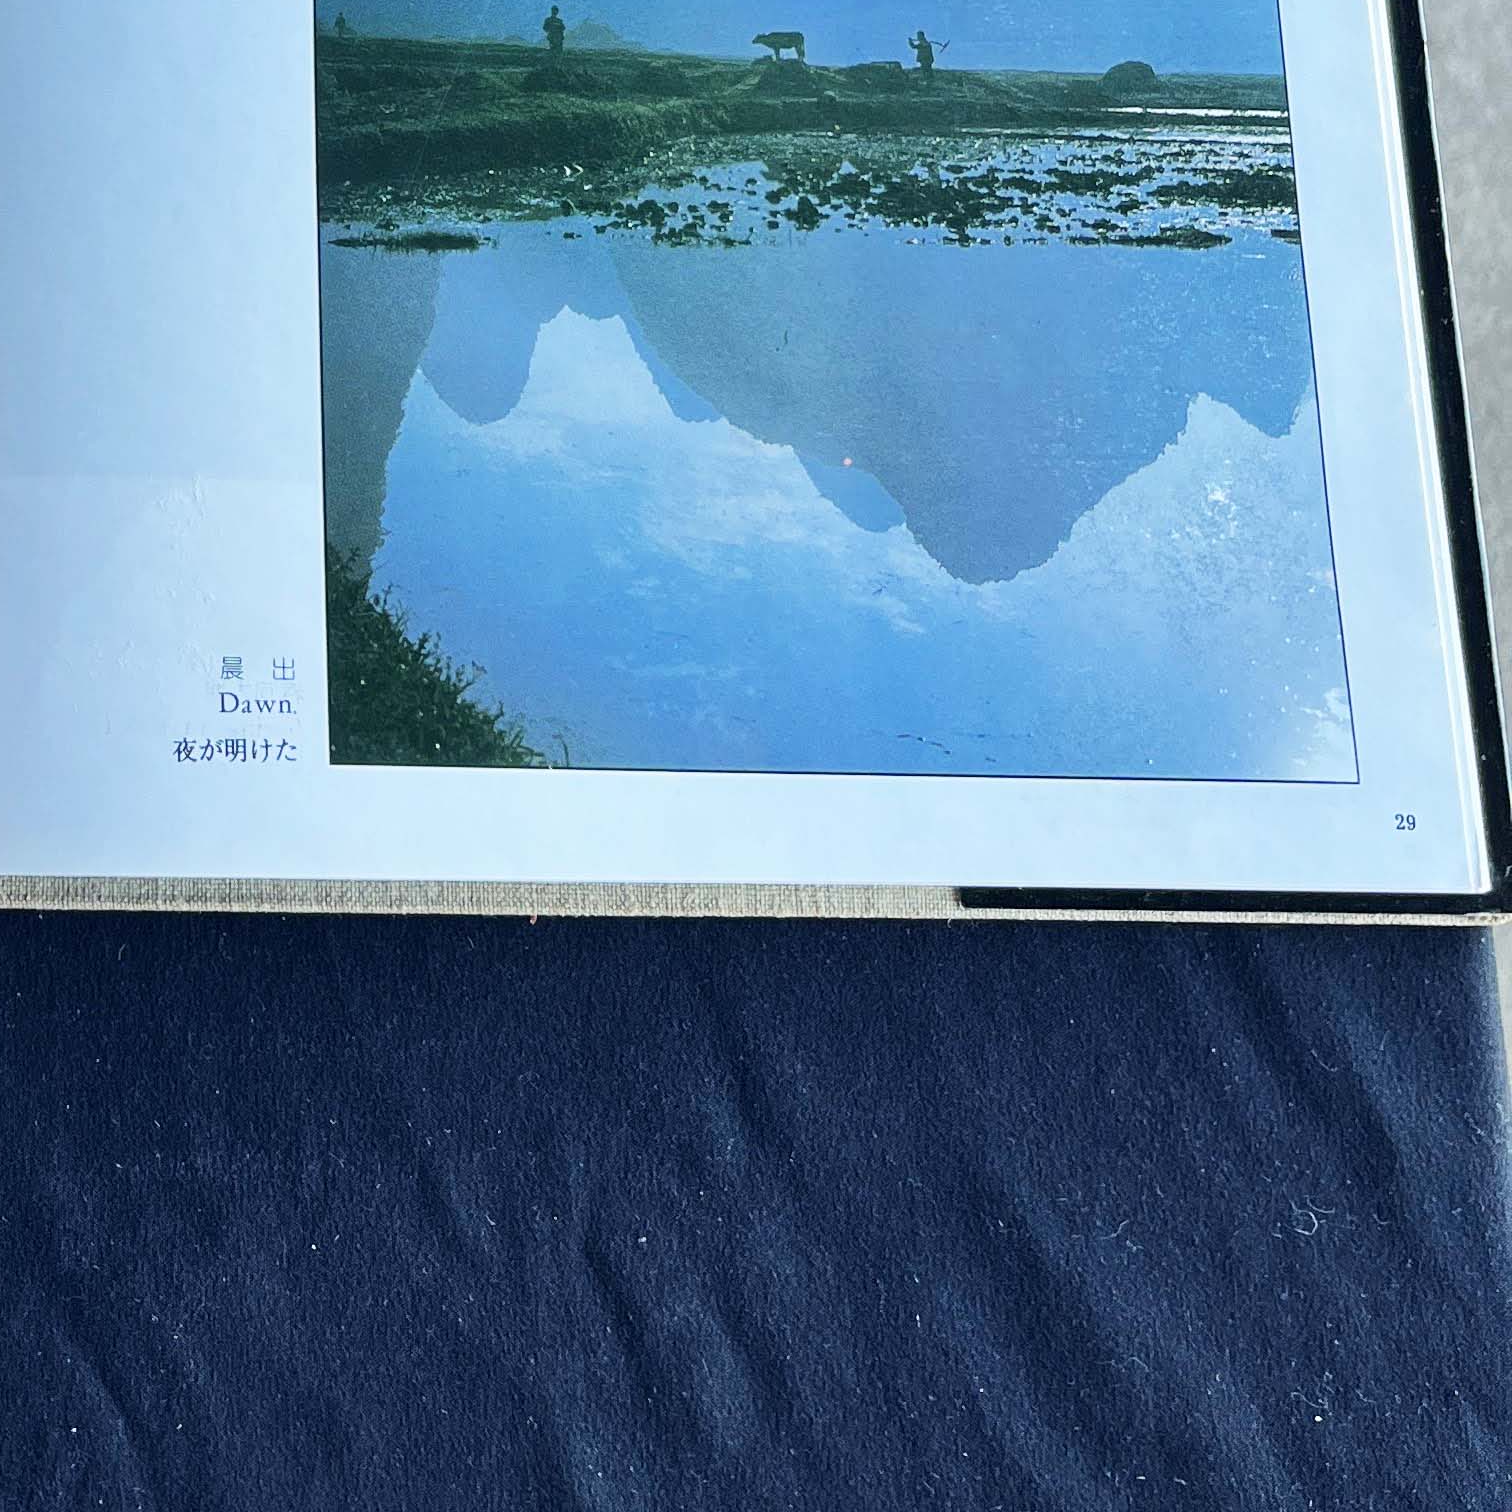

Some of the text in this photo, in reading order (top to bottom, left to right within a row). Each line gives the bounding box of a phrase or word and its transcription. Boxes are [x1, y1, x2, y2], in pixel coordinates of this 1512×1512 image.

[218, 691, 297, 715] Dawn.
[172, 737, 297, 763] 夜が明けた
[1394, 813, 1416, 831] 29
